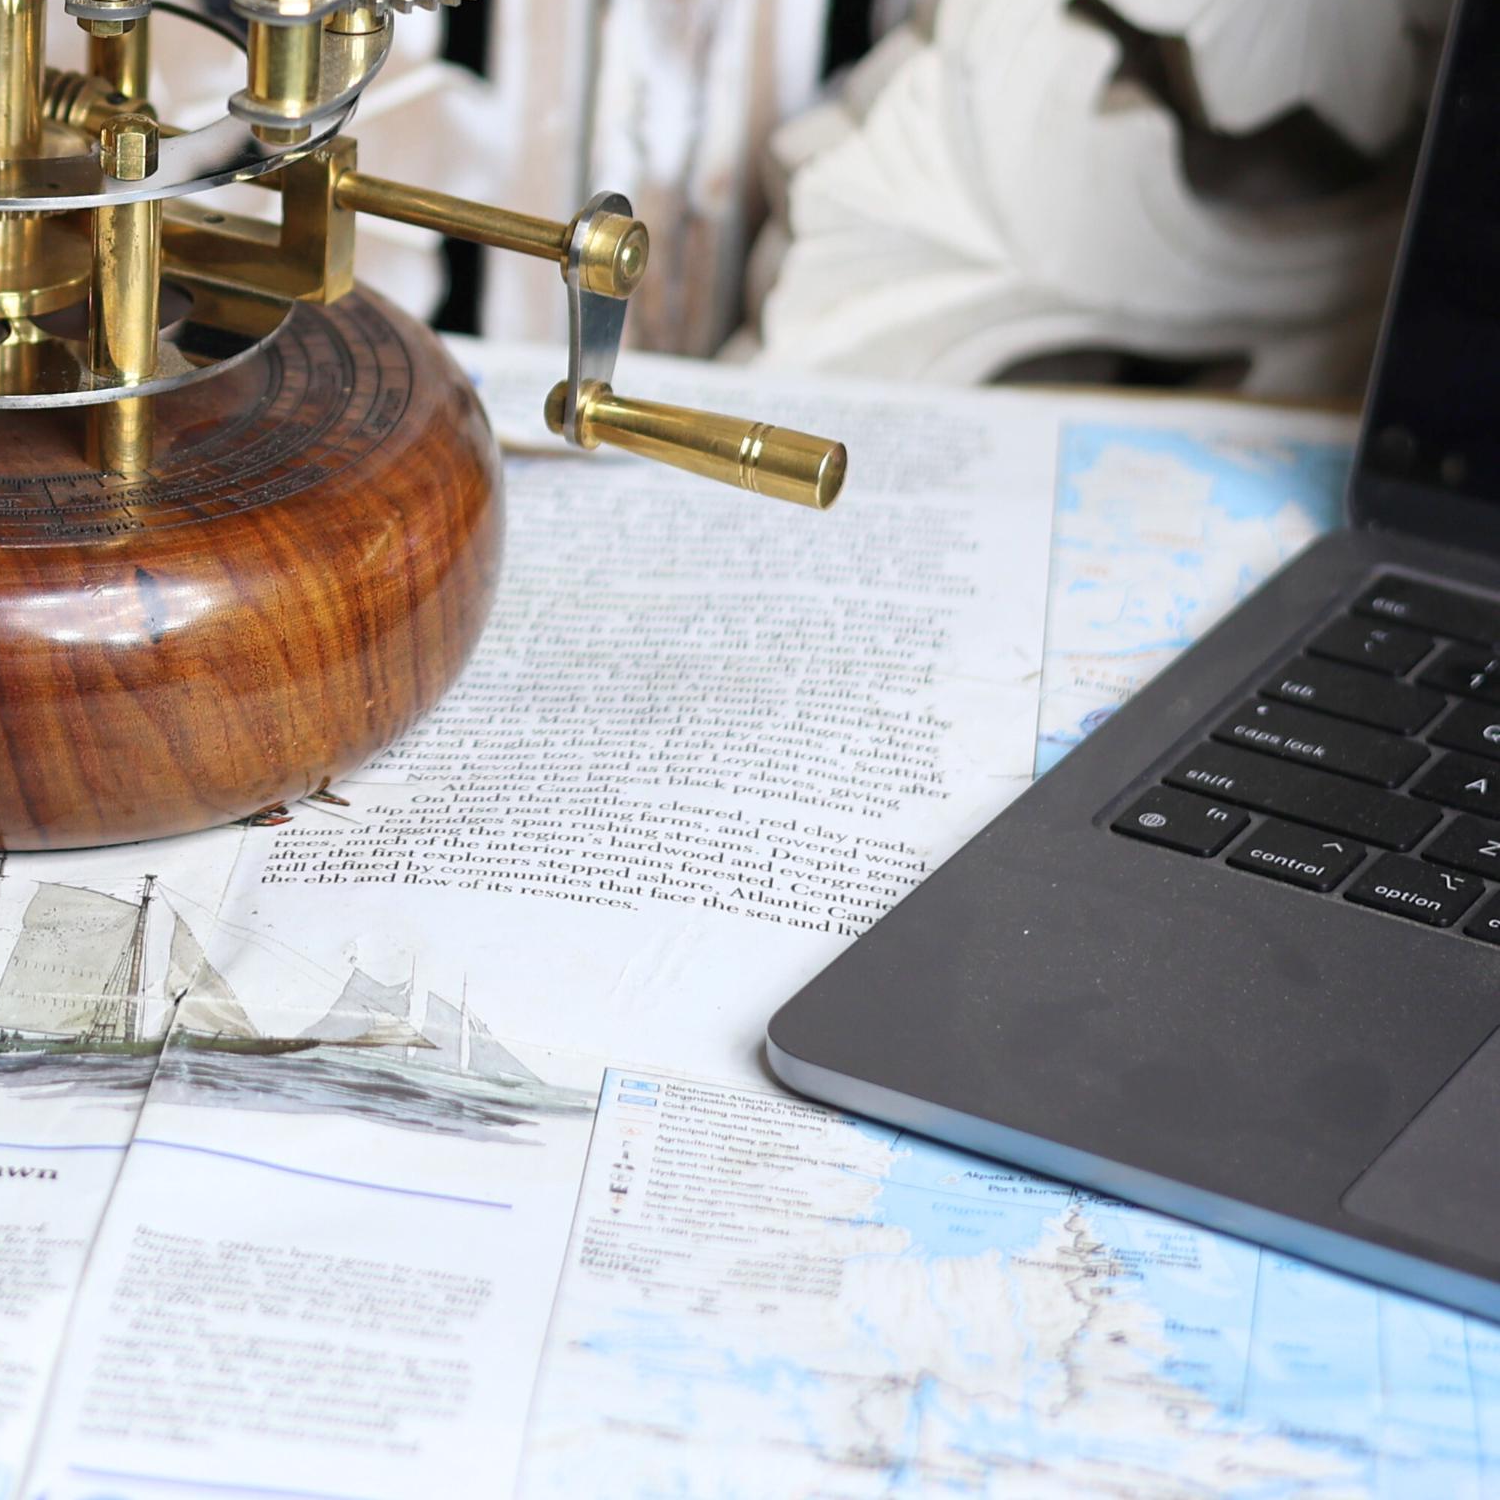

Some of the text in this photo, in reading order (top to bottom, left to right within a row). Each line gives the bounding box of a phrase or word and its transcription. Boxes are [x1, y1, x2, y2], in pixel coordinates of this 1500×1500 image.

[1372, 598, 1406, 616] esc
[1281, 681, 1314, 697] tab
[1234, 724, 1325, 758] caps lock
[406, 772, 882, 819] Nova Scotia the largest black population in
[442, 783, 628, 794] Atlantic Canada.
[1186, 769, 1235, 789] shift
[1465, 778, 1488, 794] A
[411, 795, 445, 803] On
[453, 793, 511, 802] lands
[519, 793, 562, 803] that
[568, 794, 653, 809] settlers
[659, 801, 750, 824] cleared,
[759, 817, 796, 831] red
[803, 825, 849, 843] clay
[1206, 808, 1228, 821] fn
[366, 805, 935, 873] dip and rise past rolling farms, and covered wood-
[420, 816, 504, 826] bridges
[511, 818, 563, 829] span
[571, 821, 660, 839] rushing
[664, 832, 760, 855] streams.
[771, 848, 861, 875] Despite
[1478, 840, 1500, 856] Z
[274, 839, 337, 849] trees,
[346, 837, 407, 847] much
[415, 837, 440, 846] of
[443, 837, 480, 850] the
[486, 840, 575, 857] interior
[581, 849, 674, 871] remains
[680, 862, 782, 891] forested.
[277, 827, 343, 836] ations
[350, 825, 375, 835] of
[378, 825, 461, 837] logging
[469, 826, 507, 837] the
[610, 836, 724, 864] hardwood
[731, 857, 773, 873] and
[780, 866, 898, 897] evergreen
[1250, 849, 1325, 876] control
[261, 873, 639, 911] the ebb and flow of its resources.
[264, 862, 306, 872] still
[311, 861, 400, 871] defined
[406, 862, 435, 873] by
[440, 866, 592, 889] communities
[599, 879, 644, 897] that
[650, 886, 696, 904] face
[702, 897, 740, 914] the
[745, 909, 781, 924] sea
[787, 917, 830, 934] and
[268, 849, 321, 860] after
[328, 849, 365, 858] the
[372, 849, 415, 858] first
[423, 851, 531, 867] explorers
[537, 860, 630, 880] stepped
[636, 873, 722, 896] ashore,
[730, 887, 822, 915] Atlantic
[1374, 886, 1442, 911] option
